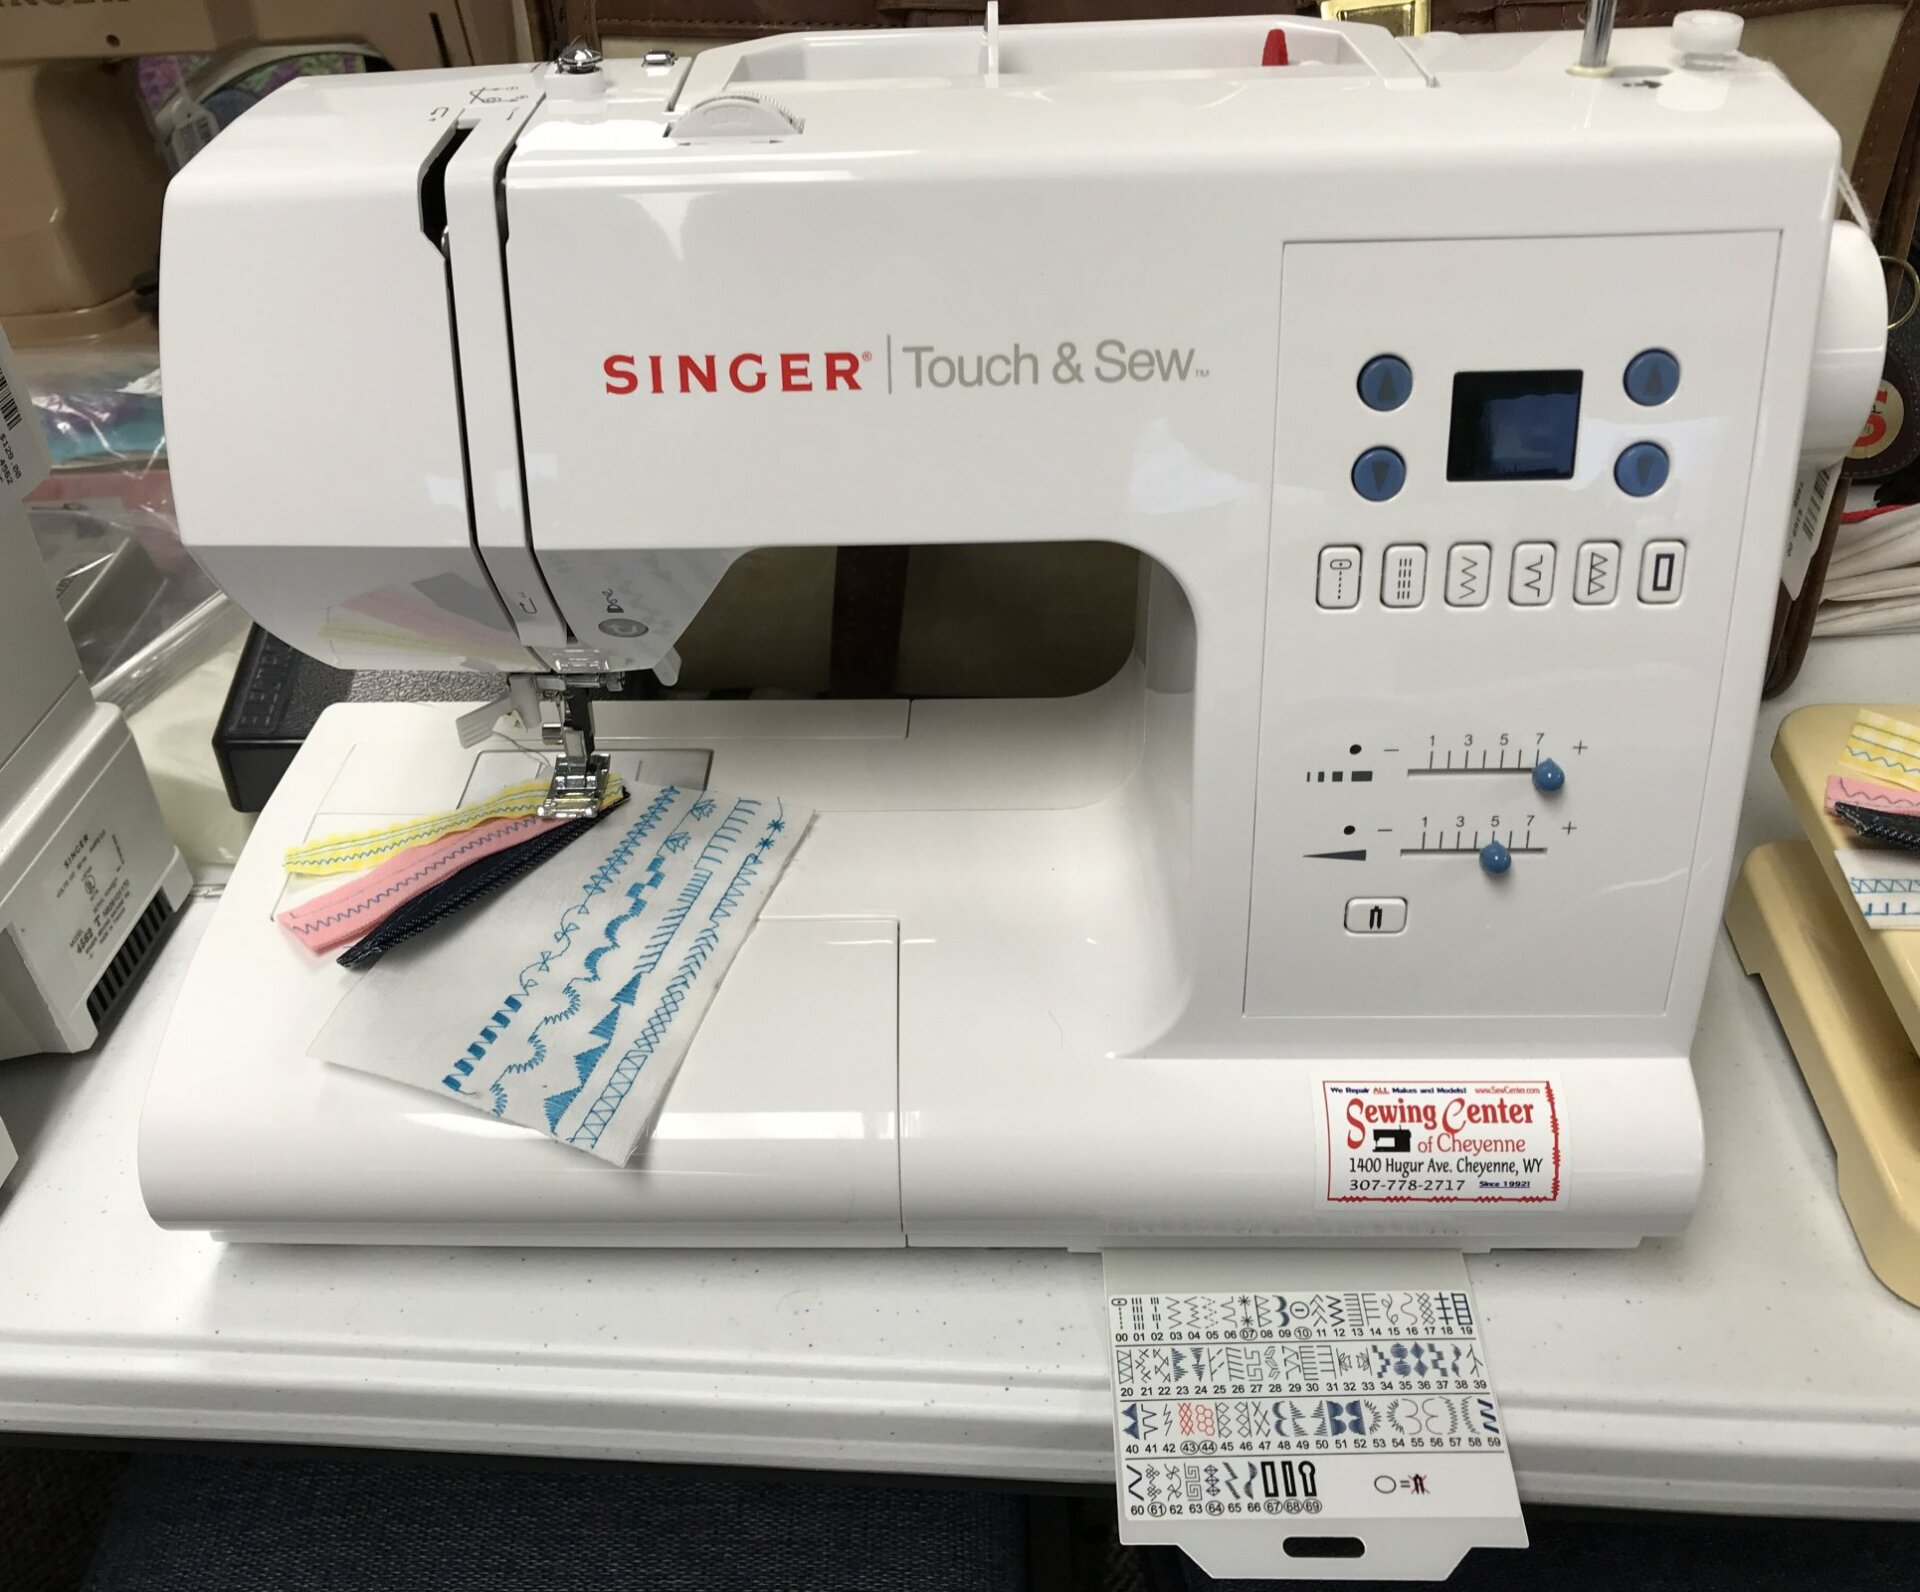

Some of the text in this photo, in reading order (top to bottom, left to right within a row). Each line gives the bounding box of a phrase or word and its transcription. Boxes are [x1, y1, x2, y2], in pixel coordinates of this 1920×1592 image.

[902, 343, 1038, 390] Touch
[1052, 341, 1085, 385] &
[1430, 733, 1545, 746] 1 3 5 7
[1422, 815, 1535, 827] 1 3 5 7
[64, 833, 89, 869] SINGER
[1345, 1086, 1370, 1095] Repair
[1373, 1086, 1390, 1095] ALL
[1392, 1086, 1418, 1094] Makes
[1475, 1084, 1540, 1095] www.SewCenter.com
[1346, 1097, 1534, 1149] Sewing Center
[1417, 1132, 1526, 1157] of Cheyenne
[1349, 1155, 1544, 1178] 1400 Hugur Ave. Cheyenne, WY
[1349, 1179, 1465, 1191] 307-778-2717
[1115, 1325, 1473, 1342] 00 01 02 03 04 05 06 07 08 09 10 11 12 13 14 15 16 17 18 19
[1120, 1380, 1487, 1396] 20 21 22 23 24 25 26 27 28 29 30 31 32 33 34 35 36 37 38 39
[1126, 1437, 1500, 1454] 40 41 42 43 44 45 46 47 48 49 50 51 52 53 54 55 56 57 58 59
[1131, 1501, 1319, 1515] 60 61 62 63 64 65 66 67 68 69
